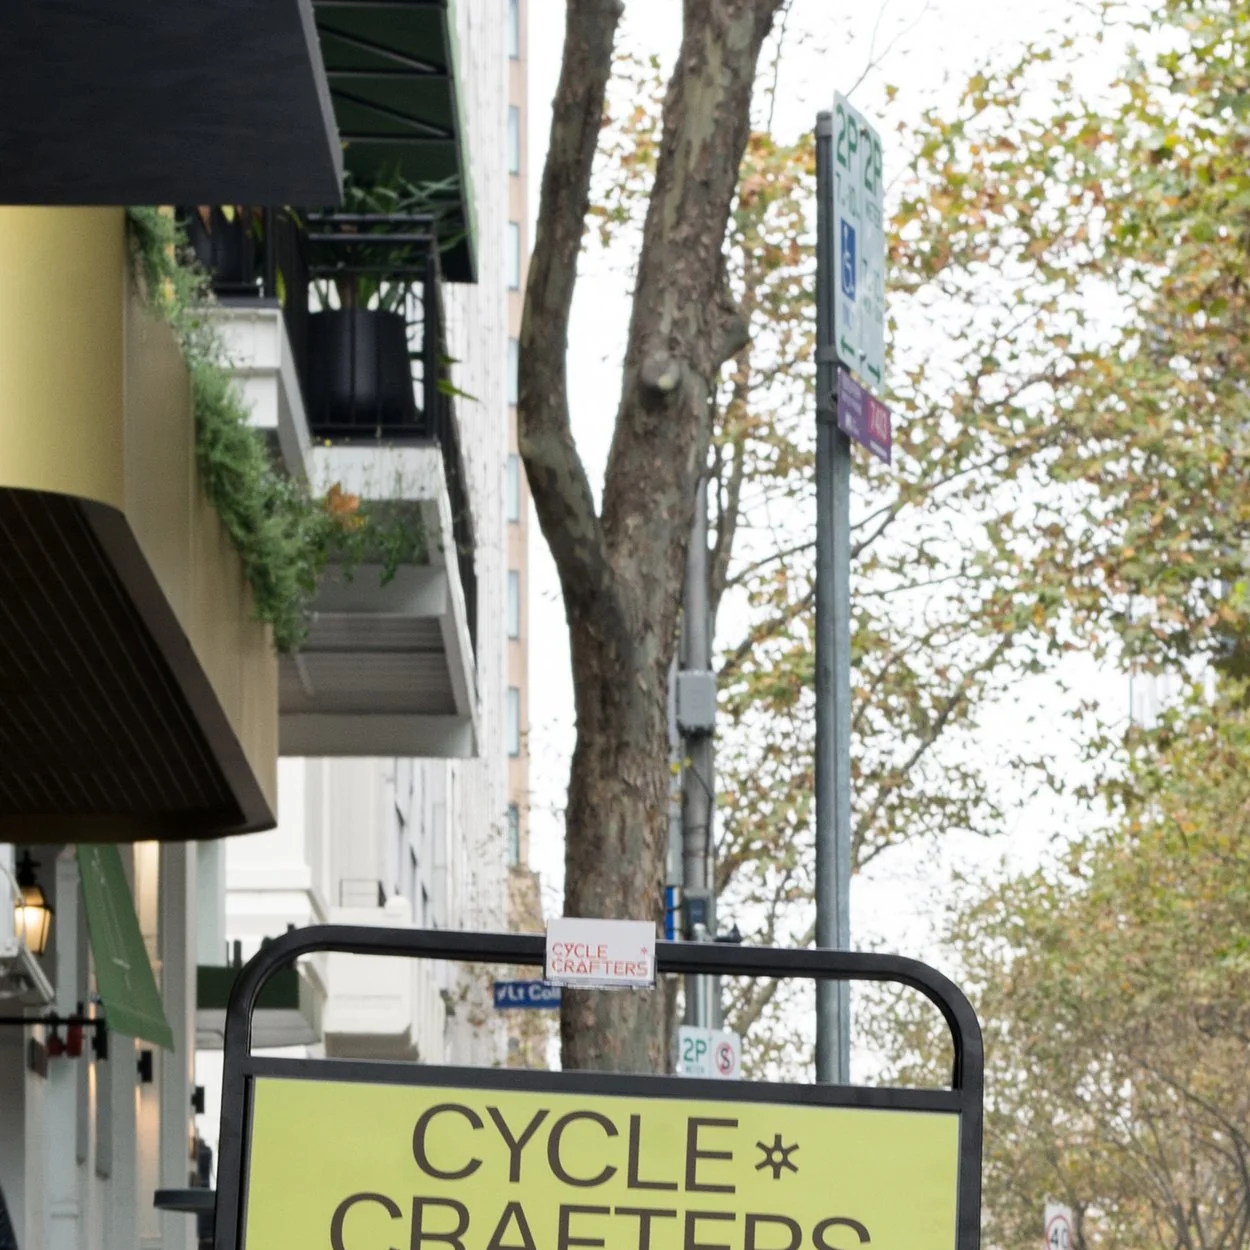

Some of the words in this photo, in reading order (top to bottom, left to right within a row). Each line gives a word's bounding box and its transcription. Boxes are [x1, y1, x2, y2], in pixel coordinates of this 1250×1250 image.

[836, 103, 857, 173] 2P
[861, 128, 882, 198] 2P
[552, 943, 608, 959] CYCLE
[552, 959, 648, 977] CRAFTERS
[684, 1038, 707, 1063] 2P
[1050, 1227, 1068, 1250] 40
